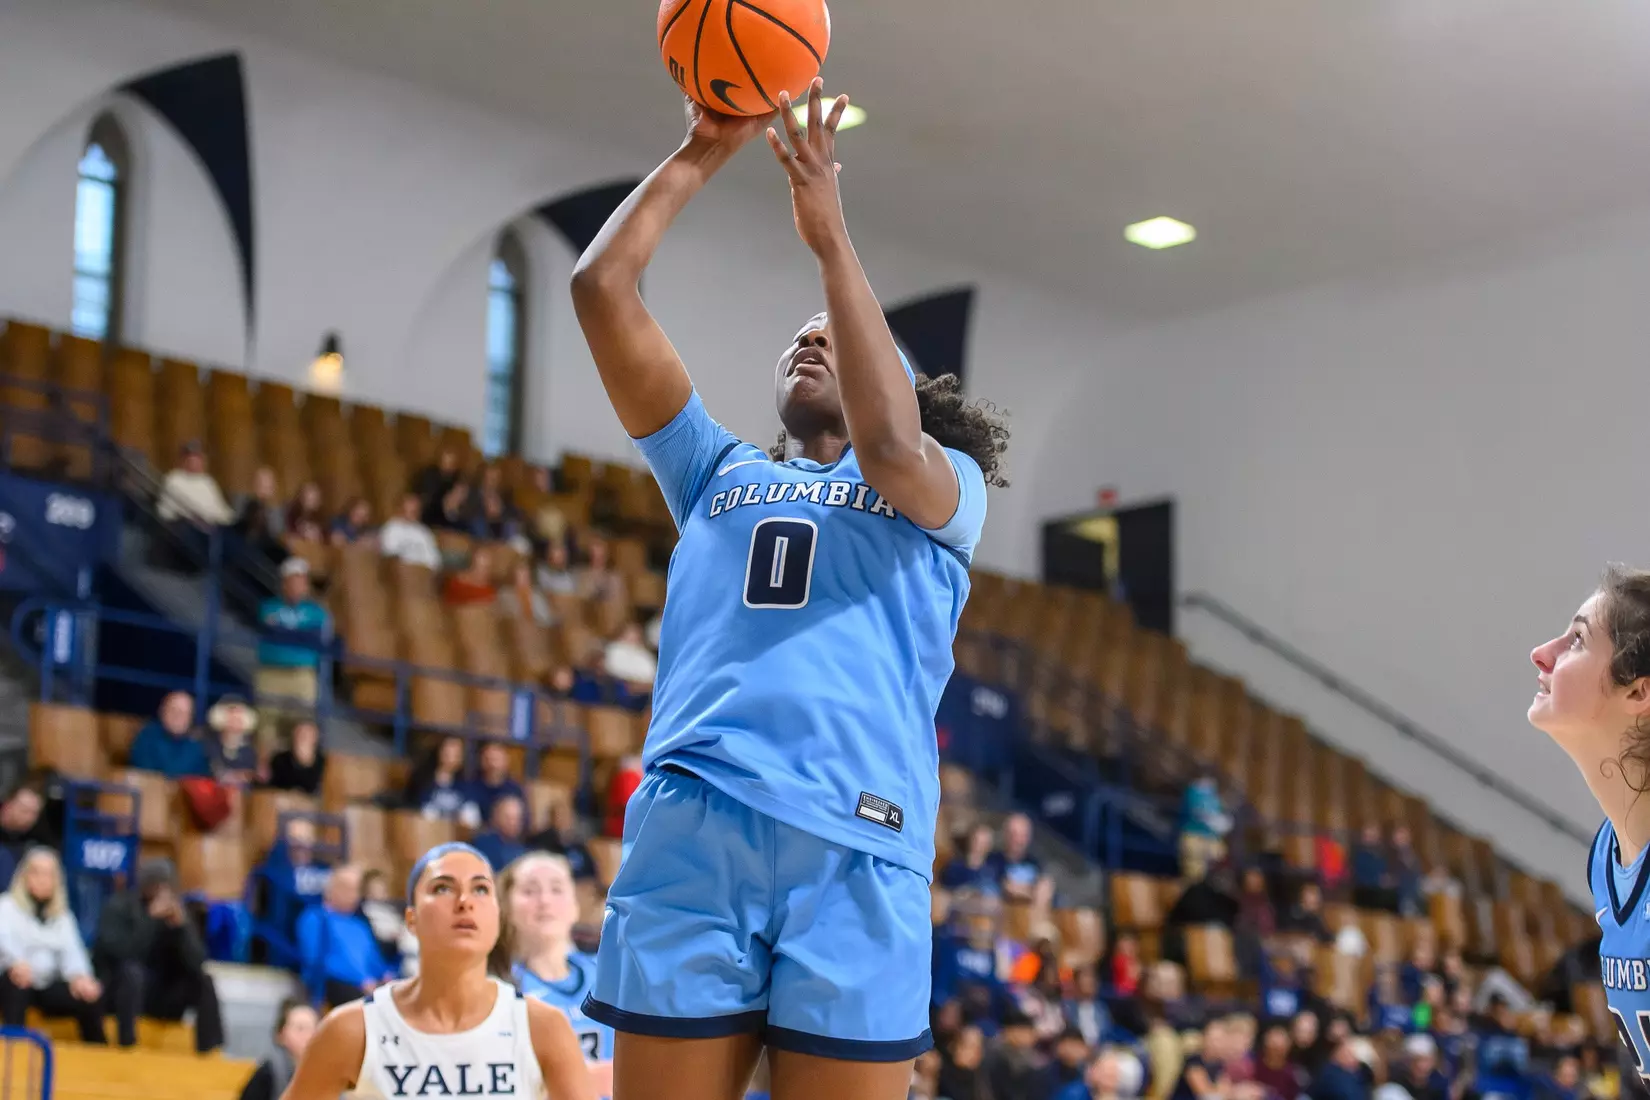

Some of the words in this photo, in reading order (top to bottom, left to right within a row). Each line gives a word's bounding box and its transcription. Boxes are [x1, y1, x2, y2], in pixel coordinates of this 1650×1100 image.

[709, 481, 897, 519] COLUMBIA
[743, 517, 818, 610] 0
[889, 809, 900, 824] XL
[1601, 955, 1650, 991] UMB
[384, 1063, 515, 1097] YALE
